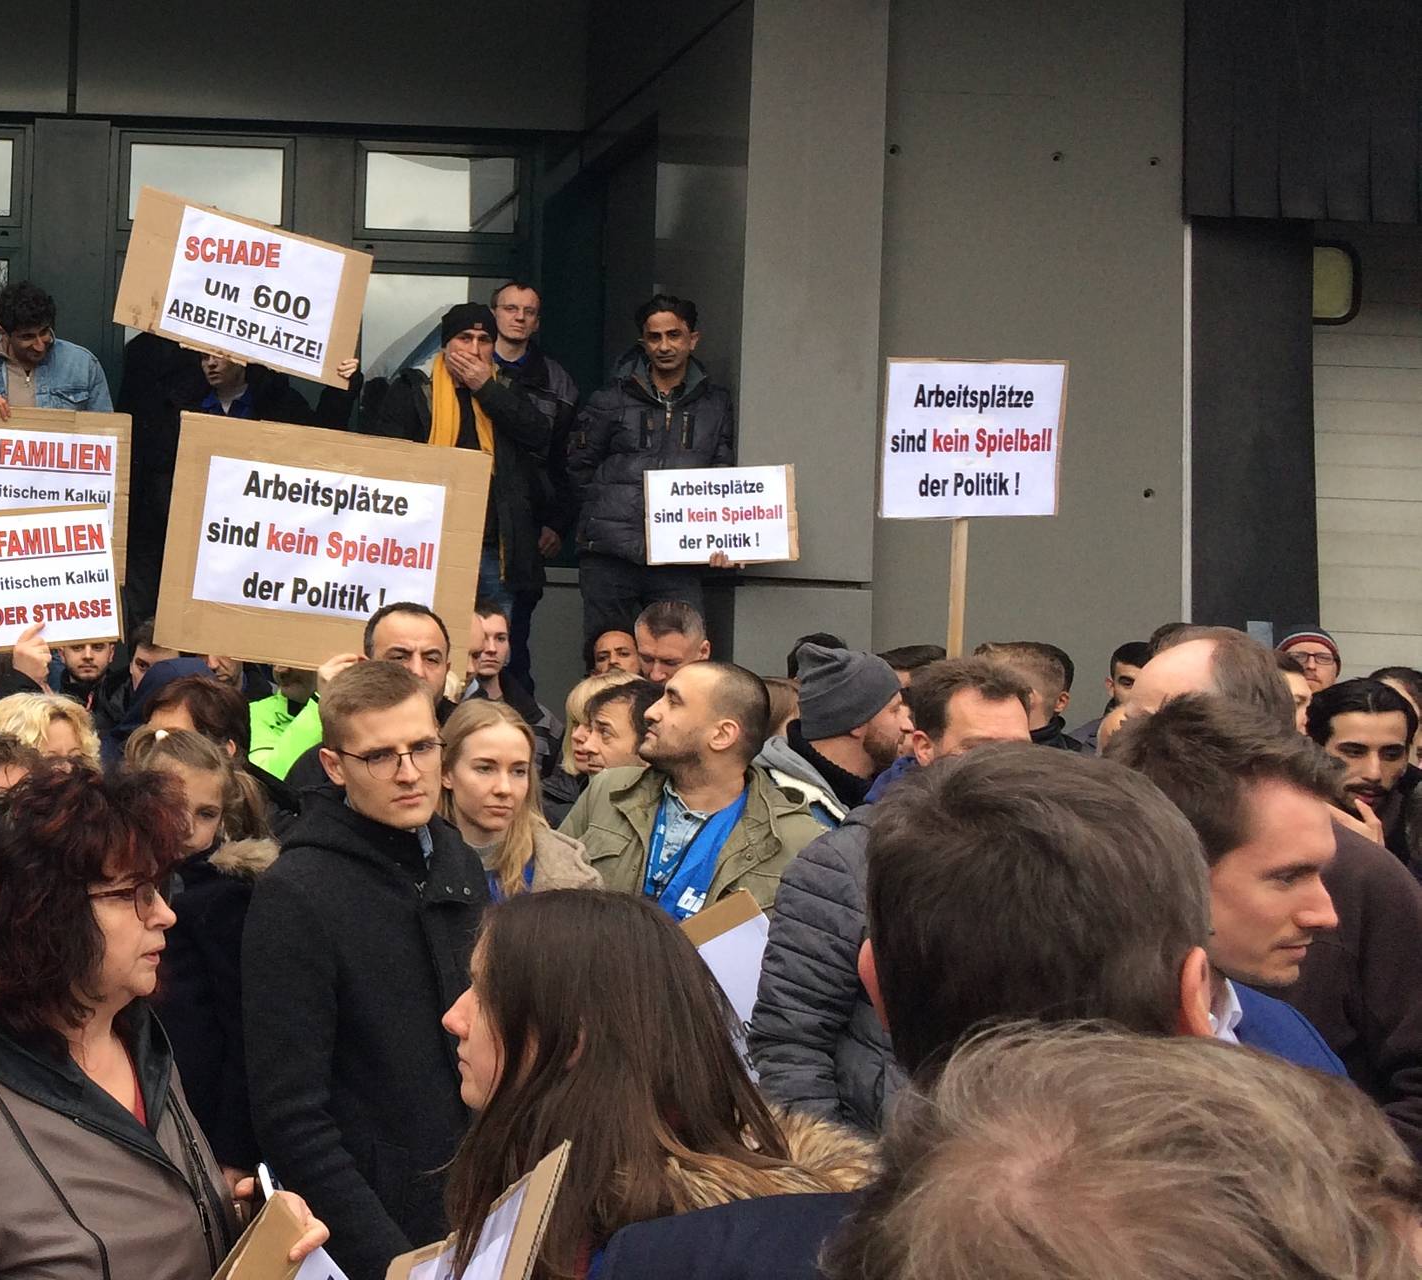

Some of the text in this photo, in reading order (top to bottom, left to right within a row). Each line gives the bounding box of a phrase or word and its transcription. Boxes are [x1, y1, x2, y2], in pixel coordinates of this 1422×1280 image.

[184, 236, 281, 268] SCHADE
[204, 278, 311, 319] UM 600
[167, 298, 323, 360] ARBEITSPLÄTZE!
[914, 383, 1034, 414] Arbeitsplätze
[890, 428, 1052, 458] sind kein Spielball
[65, 488, 111, 504] Kalkül
[243, 470, 409, 516] Arbeitsplätze
[670, 480, 764, 498] Arbeitsplätze
[919, 472, 1020, 497] der Politik !
[654, 504, 783, 525] sind kein Spielball
[207, 517, 434, 570] sind kein Spielball
[679, 532, 760, 549] der Politik !
[65, 569, 109, 585] Kalkül
[243, 572, 284, 602] der
[290, 577, 371, 613] Politik
[33, 599, 112, 622] STRASSE
